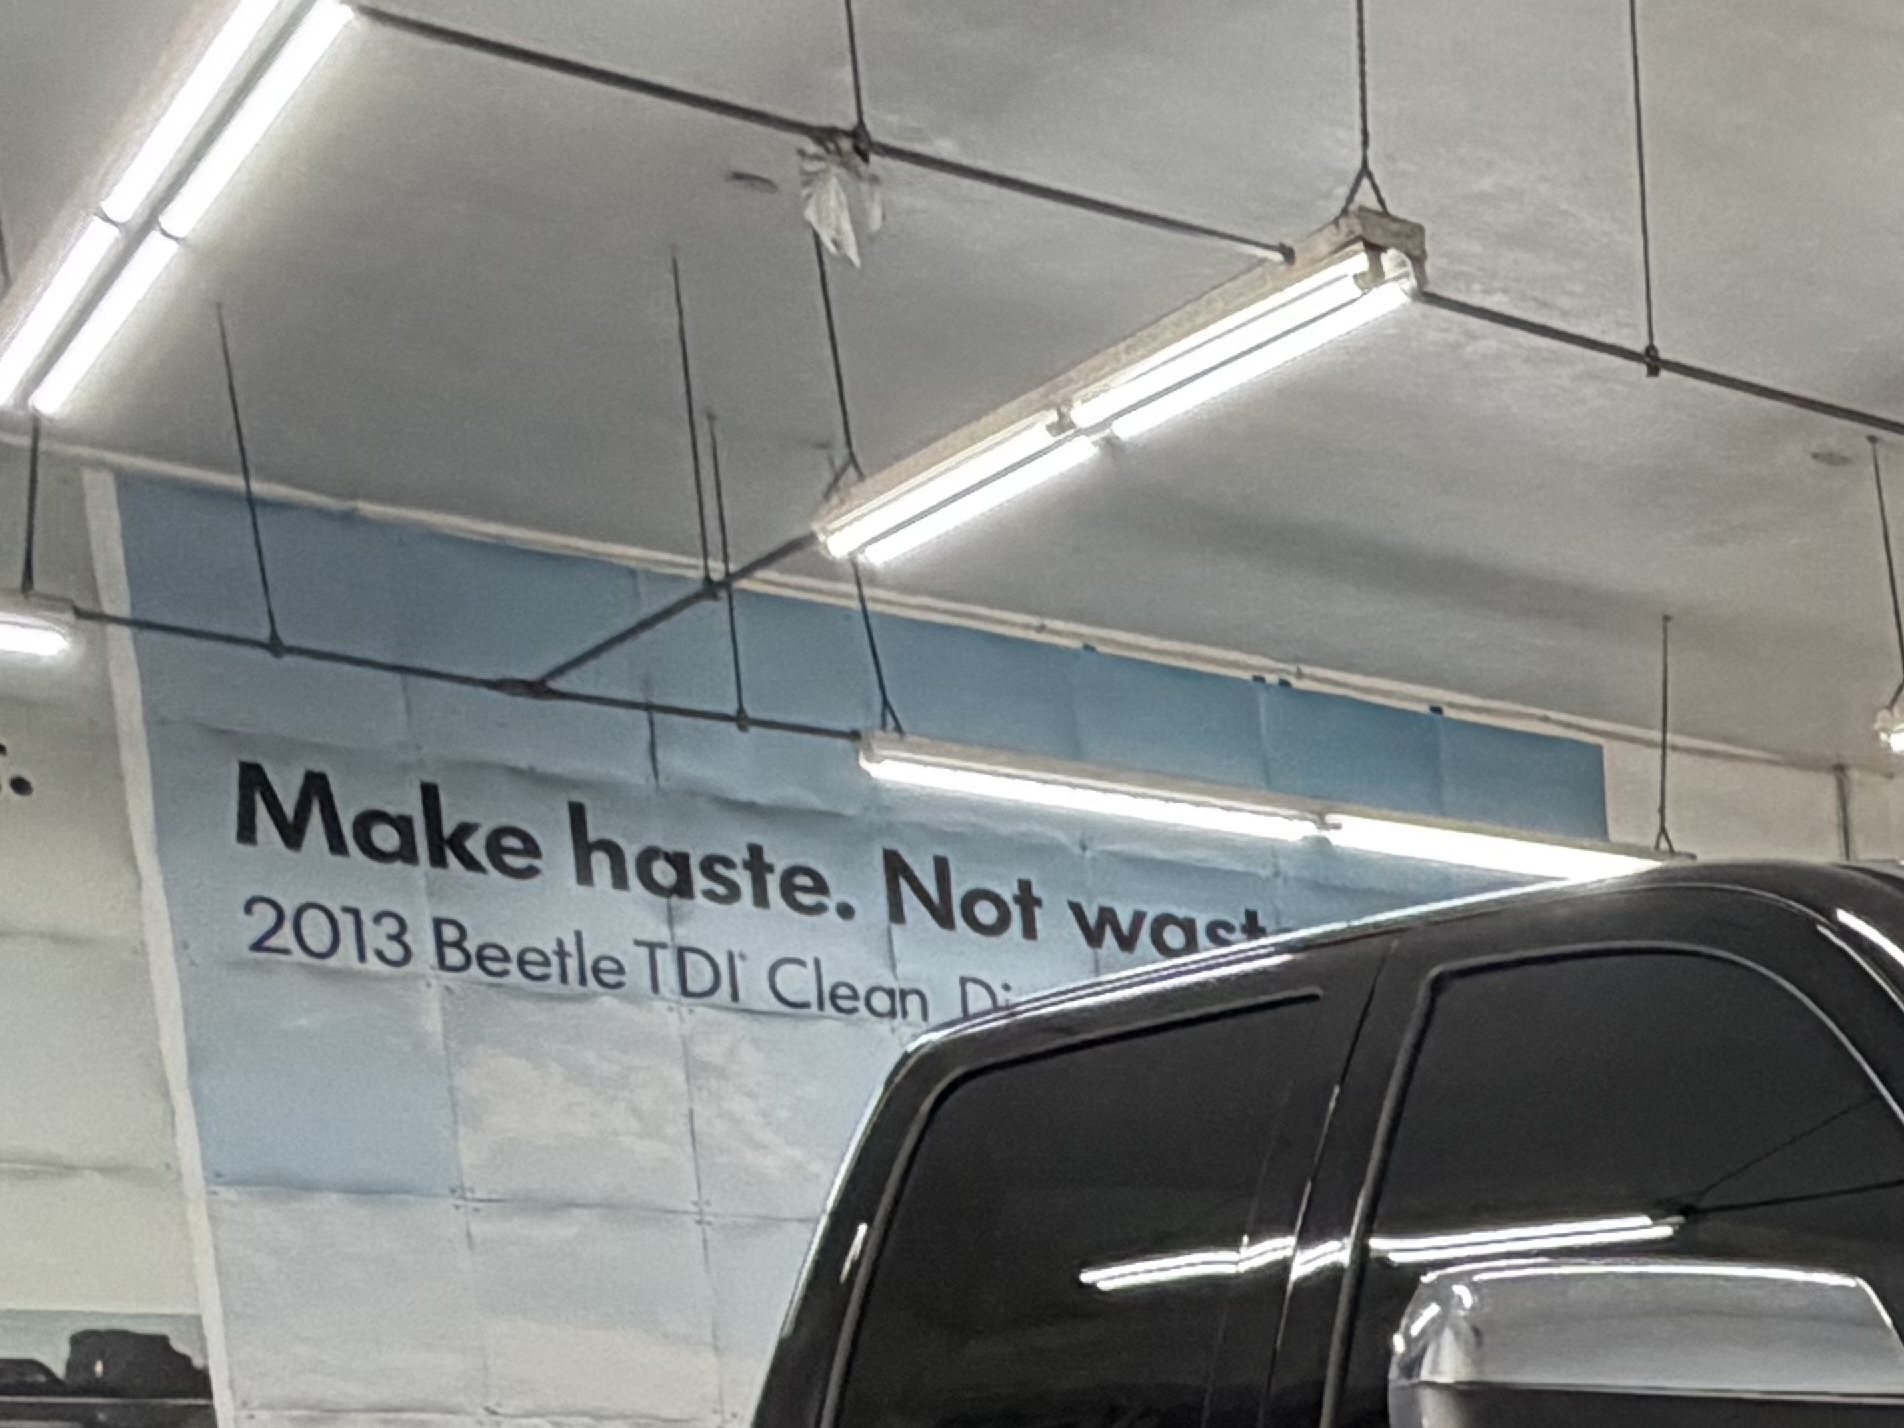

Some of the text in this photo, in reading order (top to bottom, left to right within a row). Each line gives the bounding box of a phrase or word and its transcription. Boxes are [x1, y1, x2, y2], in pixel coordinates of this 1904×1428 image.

[236, 760, 1292, 958] Make haste. Not wast
[243, 895, 413, 968] 2013
[433, 917, 627, 990] Beetle
[768, 956, 929, 1021] Clean
